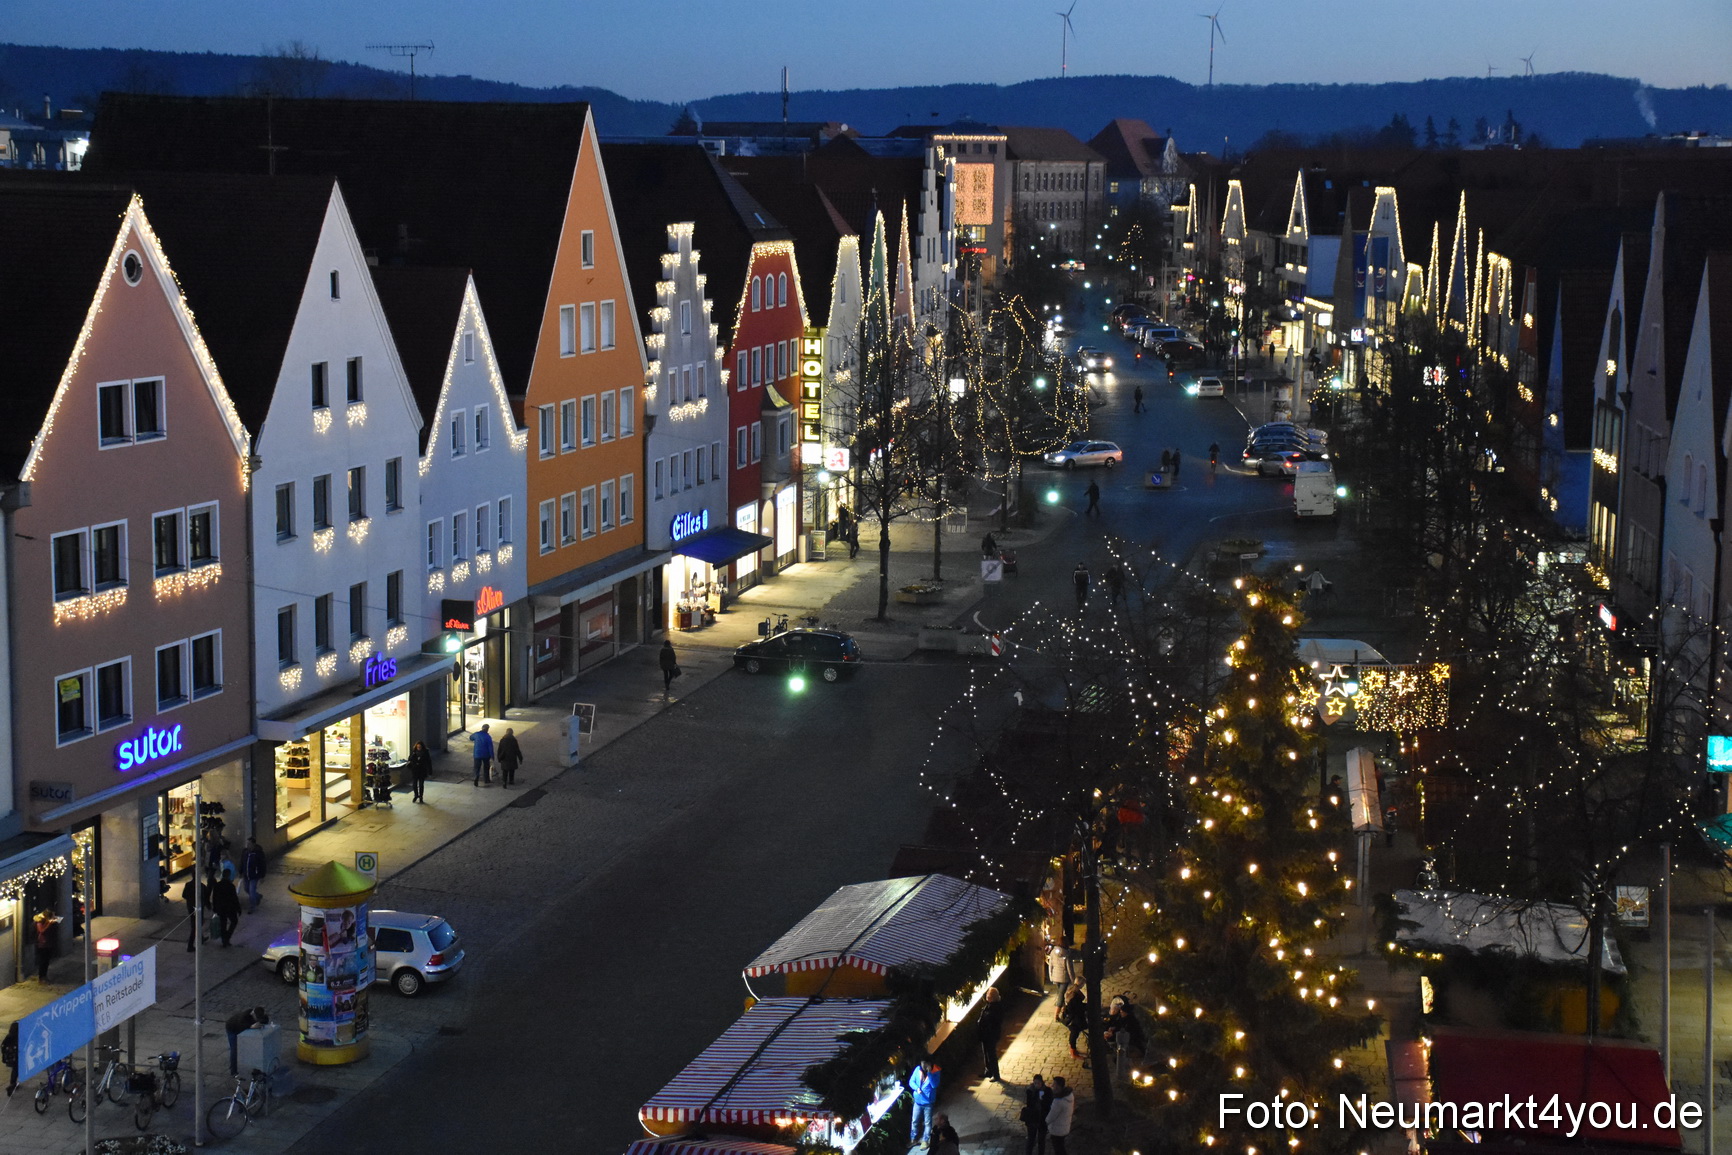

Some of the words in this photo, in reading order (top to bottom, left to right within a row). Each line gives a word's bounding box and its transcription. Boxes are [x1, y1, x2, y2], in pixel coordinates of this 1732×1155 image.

[803, 338, 822, 441] HOTEL
[94, 1001, 104, 1015] im
[105, 975, 145, 1007] Reitstadel
